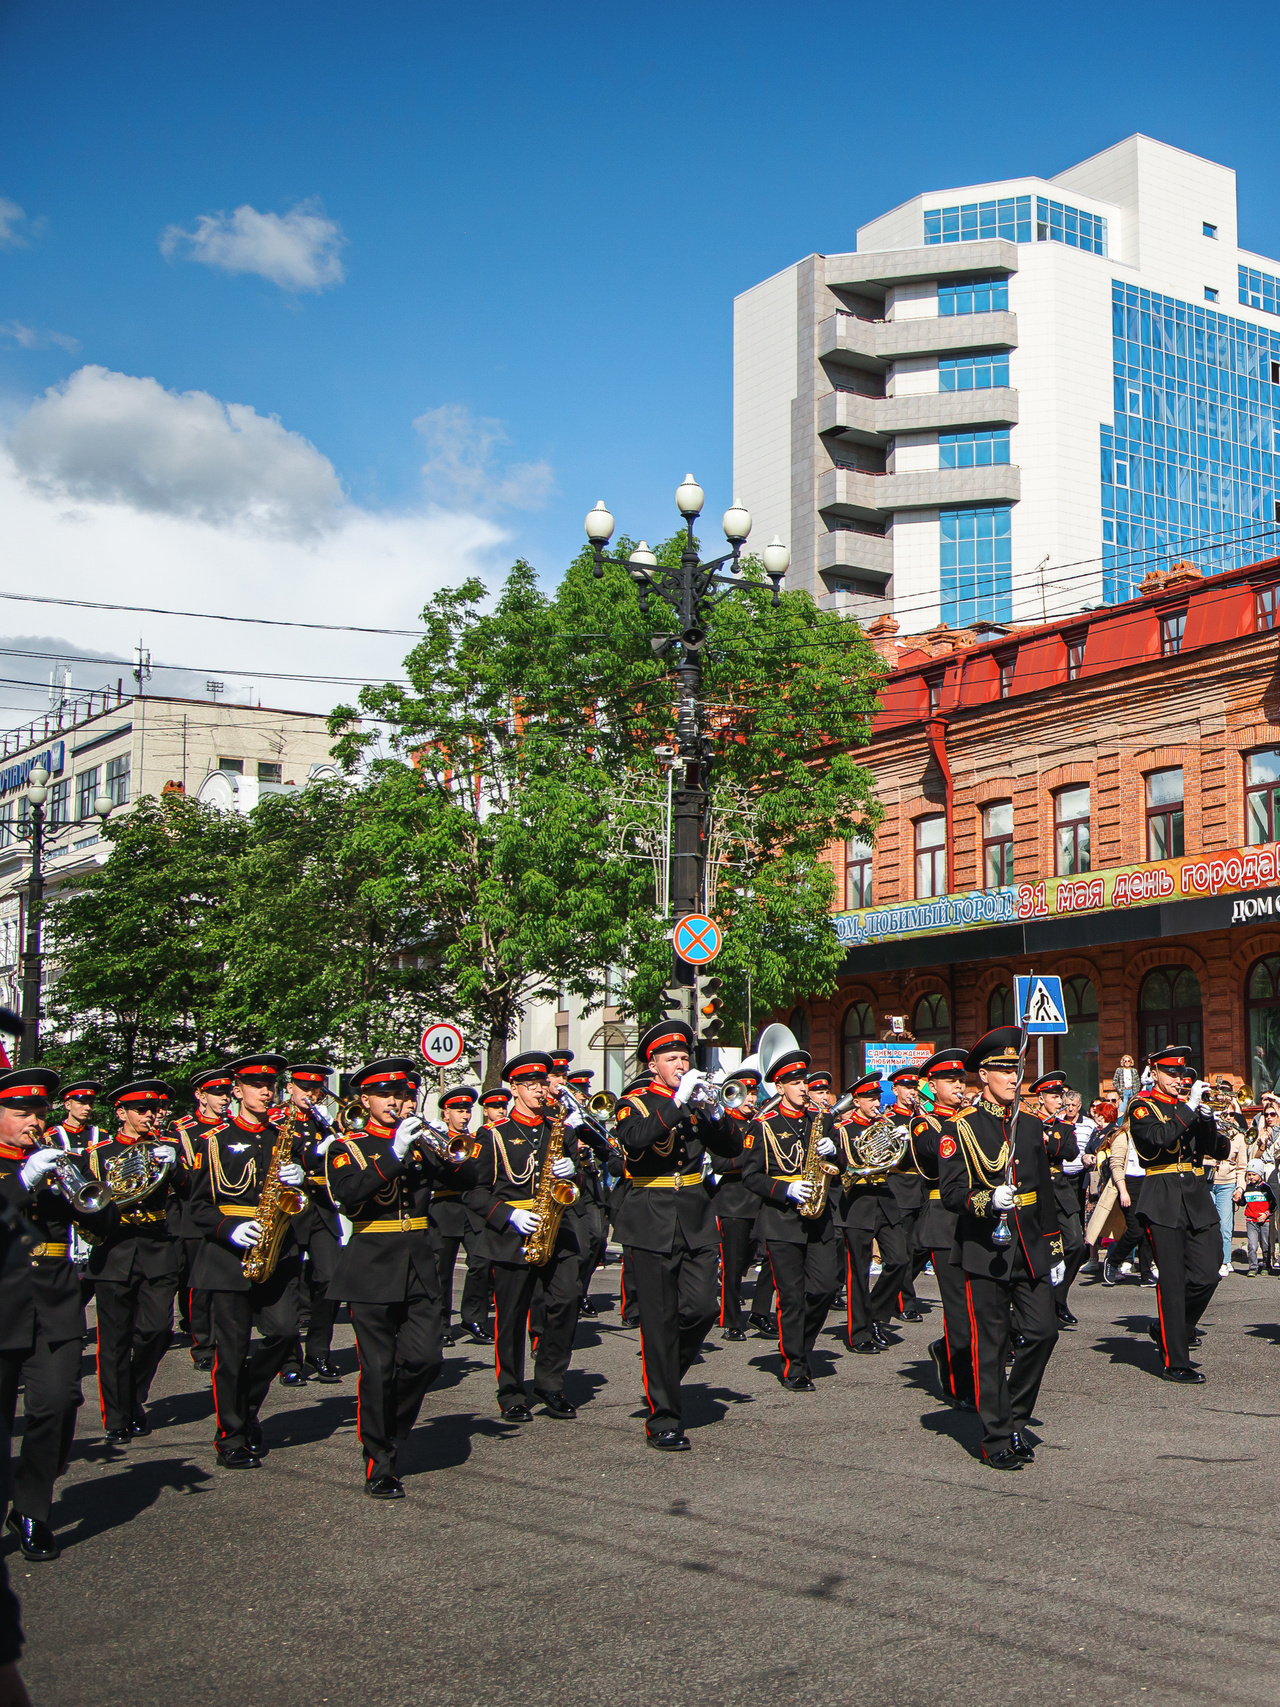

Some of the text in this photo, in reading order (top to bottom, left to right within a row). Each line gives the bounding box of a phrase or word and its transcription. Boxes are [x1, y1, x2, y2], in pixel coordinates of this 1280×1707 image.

[829, 915, 863, 942] ОМ,
[864, 896, 951, 937] ЛЮБИМЫЙ
[952, 891, 1013, 924] ГОРОД!
[1018, 881, 1049, 920] 31
[1056, 878, 1105, 914] мая
[1112, 868, 1175, 908] день
[1231, 896, 1273, 923] ДОМ
[430, 1035, 454, 1053] 40
